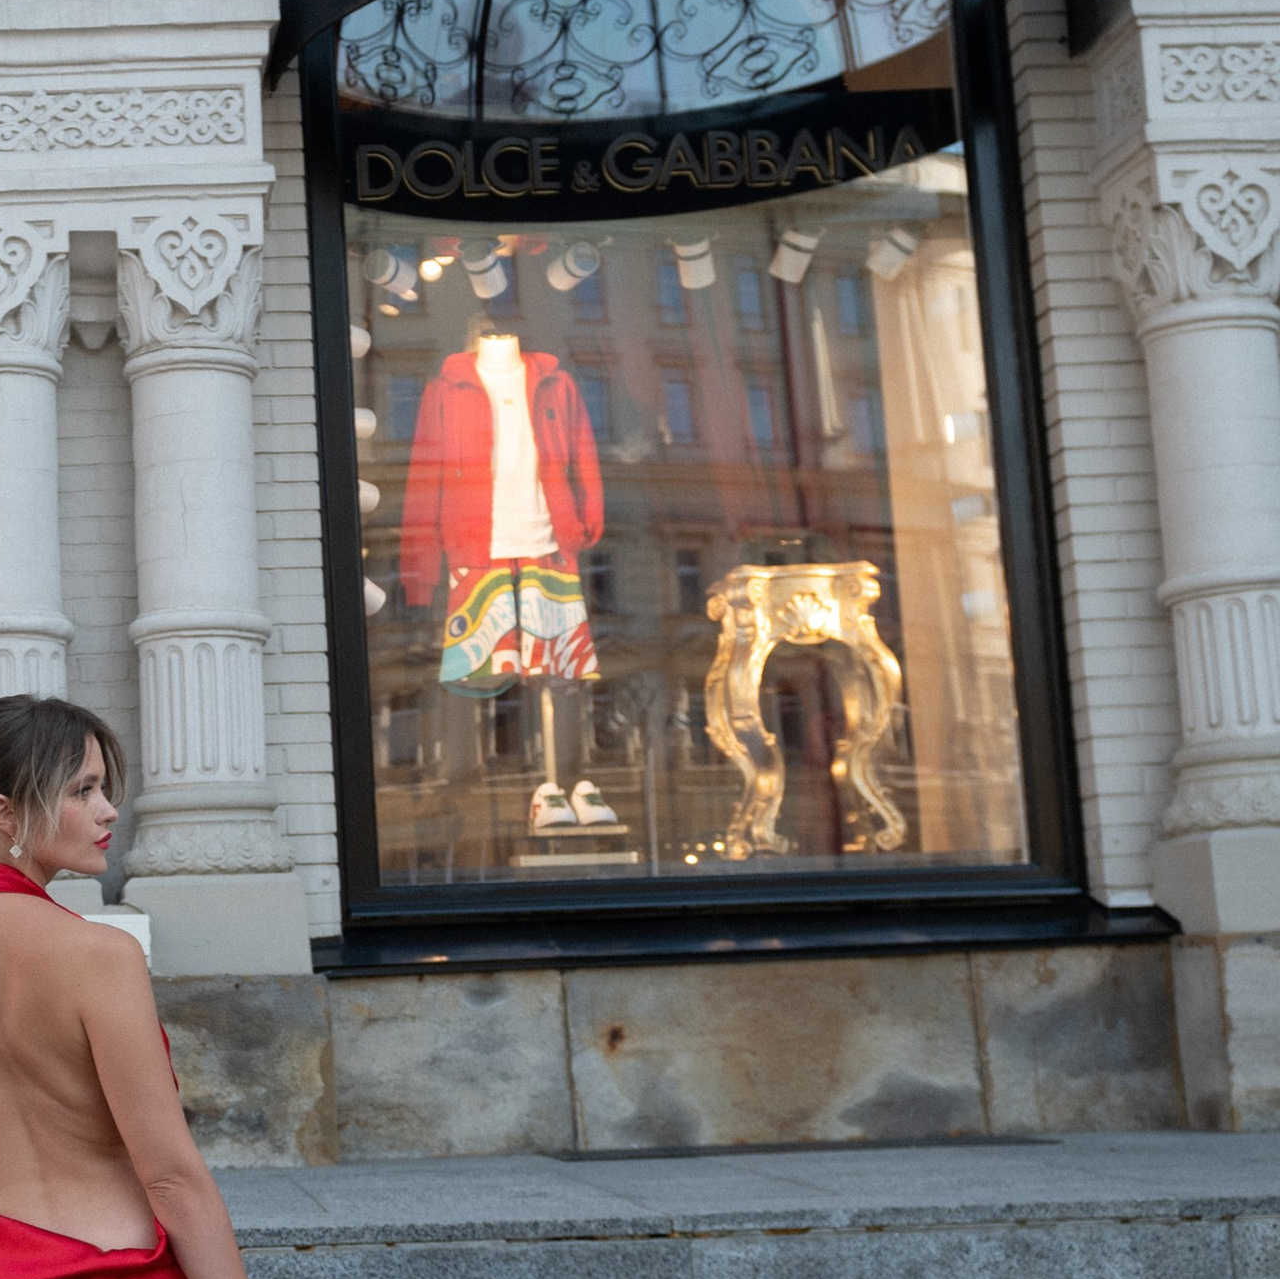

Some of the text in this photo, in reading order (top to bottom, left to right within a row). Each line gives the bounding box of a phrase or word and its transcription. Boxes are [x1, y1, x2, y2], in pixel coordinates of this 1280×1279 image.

[356, 125, 928, 201] DOLCE & GABBANA
